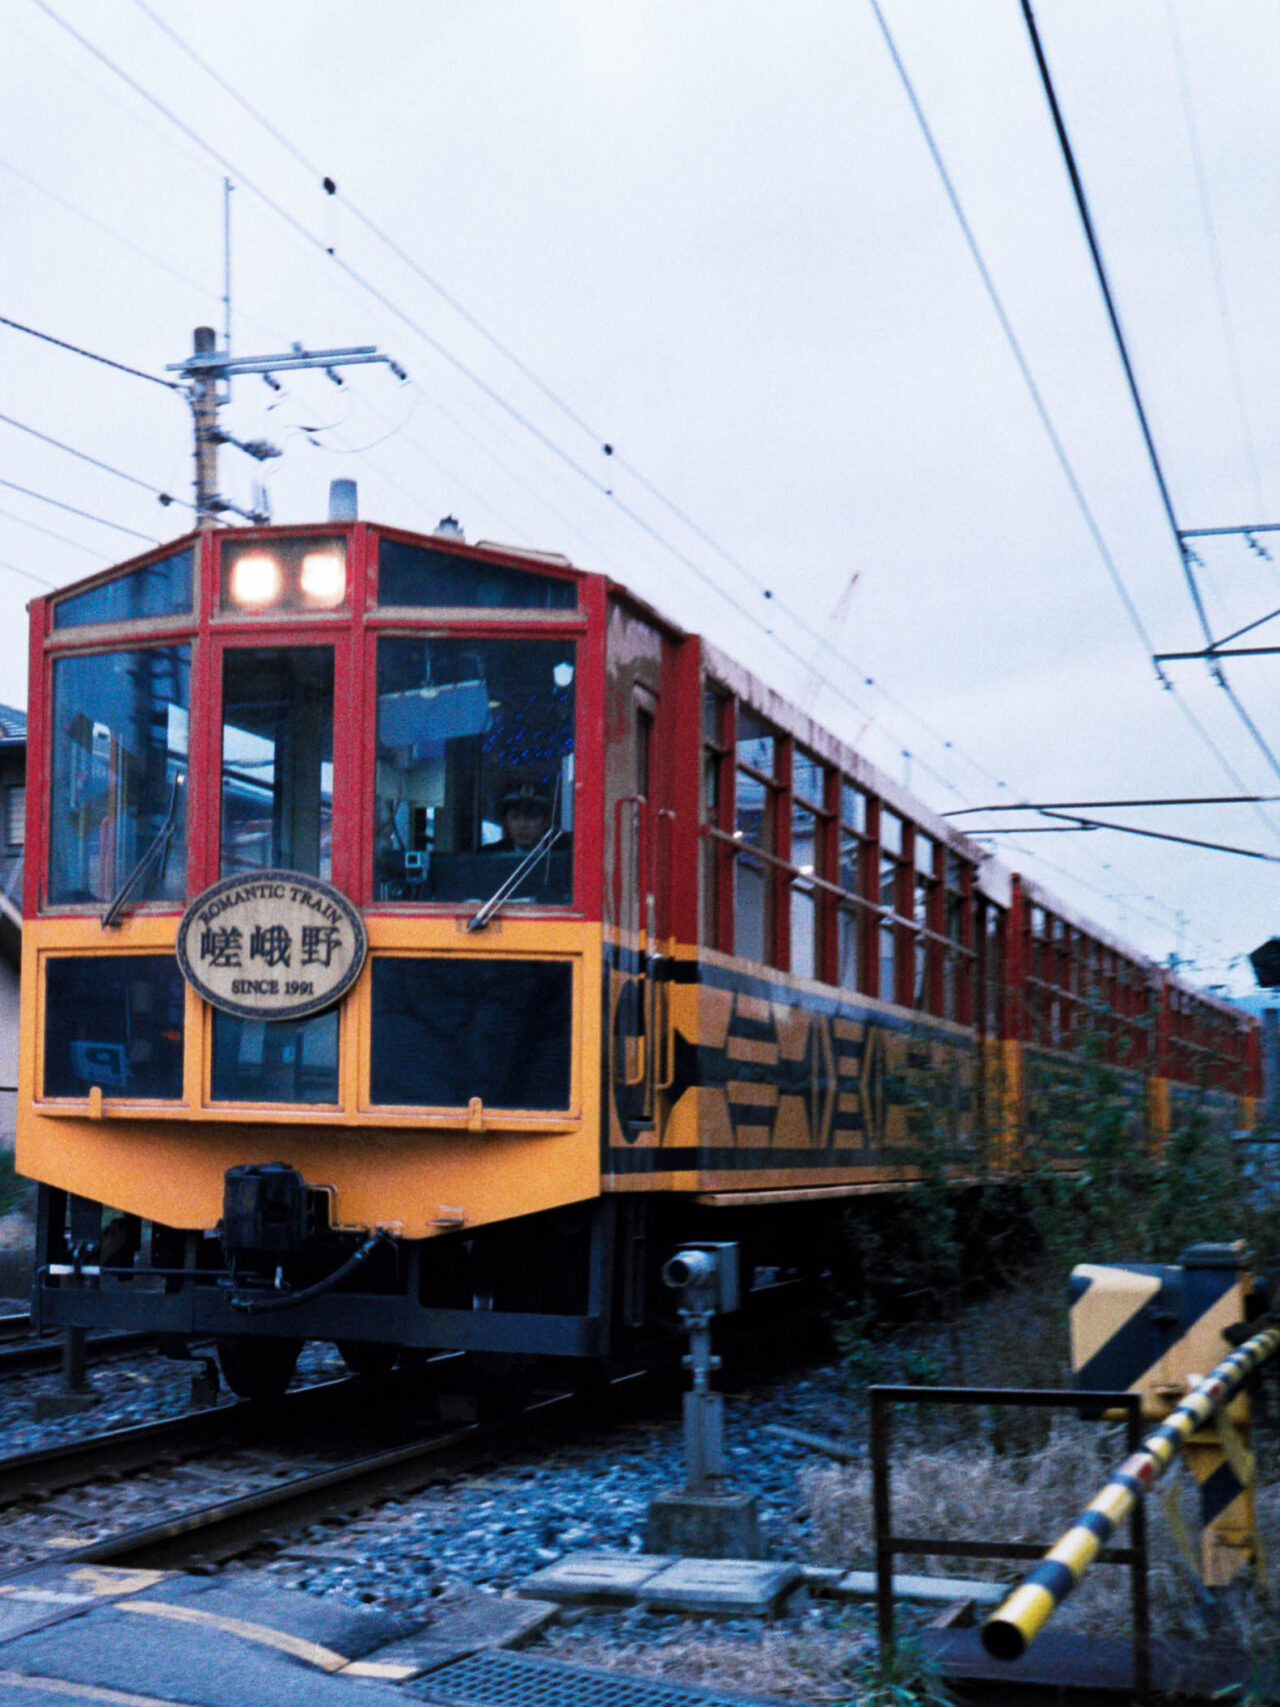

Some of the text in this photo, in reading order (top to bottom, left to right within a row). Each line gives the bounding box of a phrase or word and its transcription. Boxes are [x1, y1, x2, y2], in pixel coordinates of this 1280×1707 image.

[199, 884, 342, 925] ROMANTIC TRAIN
[200, 924, 342, 968] 嵯峨野
[231, 979, 314, 995] SINCE 1991
